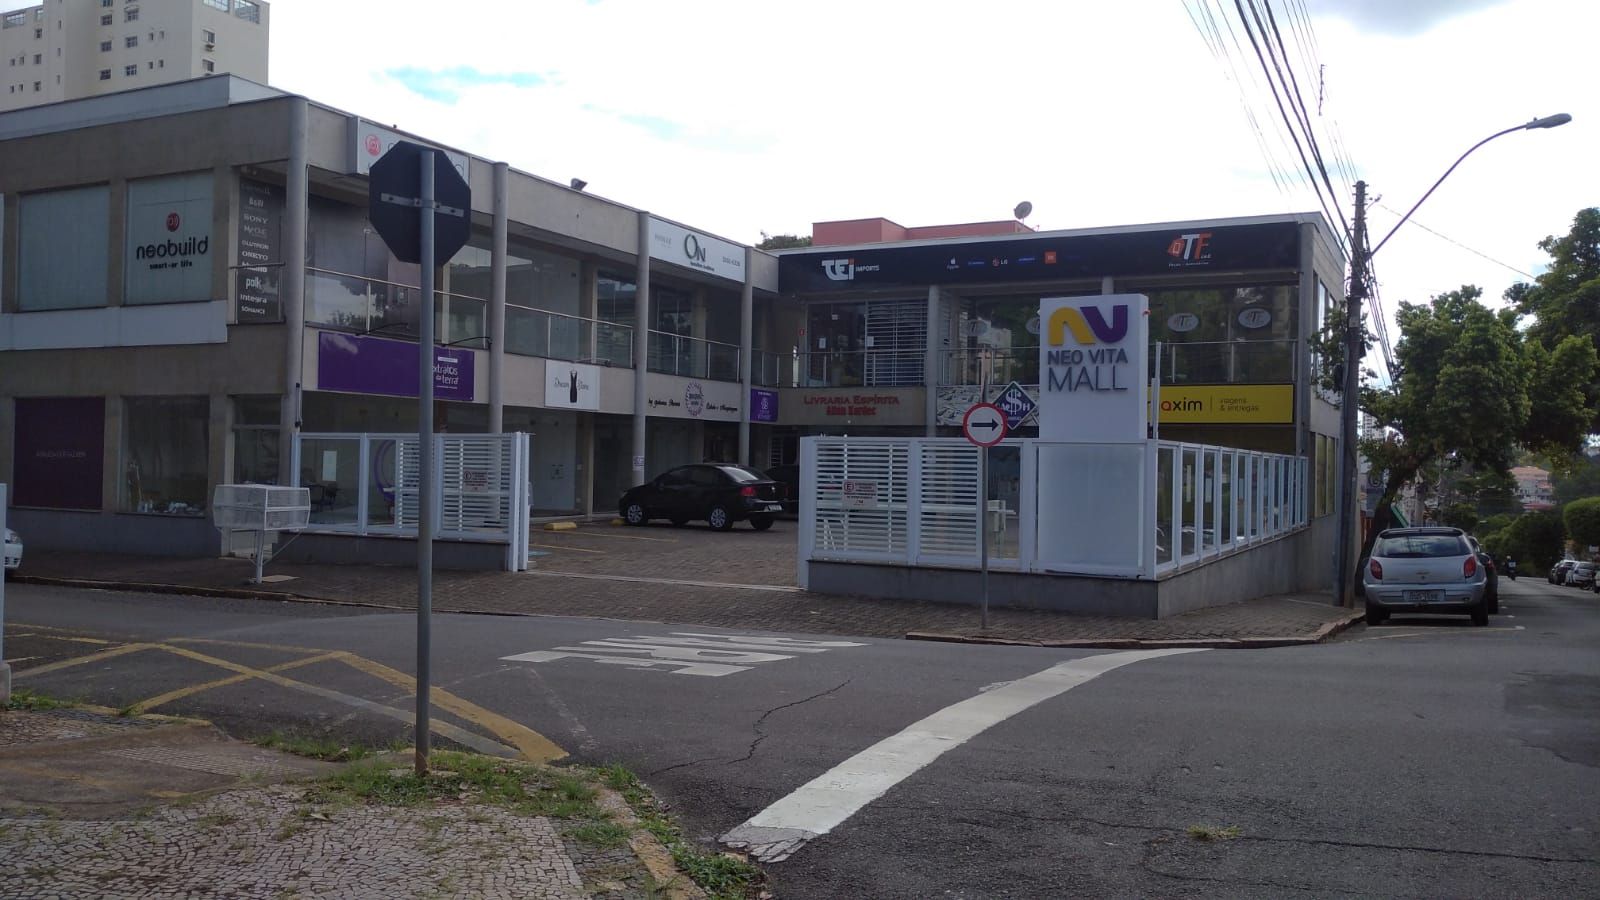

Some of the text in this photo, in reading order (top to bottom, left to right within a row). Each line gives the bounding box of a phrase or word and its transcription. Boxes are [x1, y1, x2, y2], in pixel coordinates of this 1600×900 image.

[243, 213, 268, 224] SONY
[136, 235, 209, 260] neobuild
[855, 264, 880, 272] IMPORTS
[245, 276, 263, 290] polk
[1047, 348, 1128, 365] NEO VITA
[1048, 365, 1128, 392] MALL
[1147, 396, 1202, 411] axim
